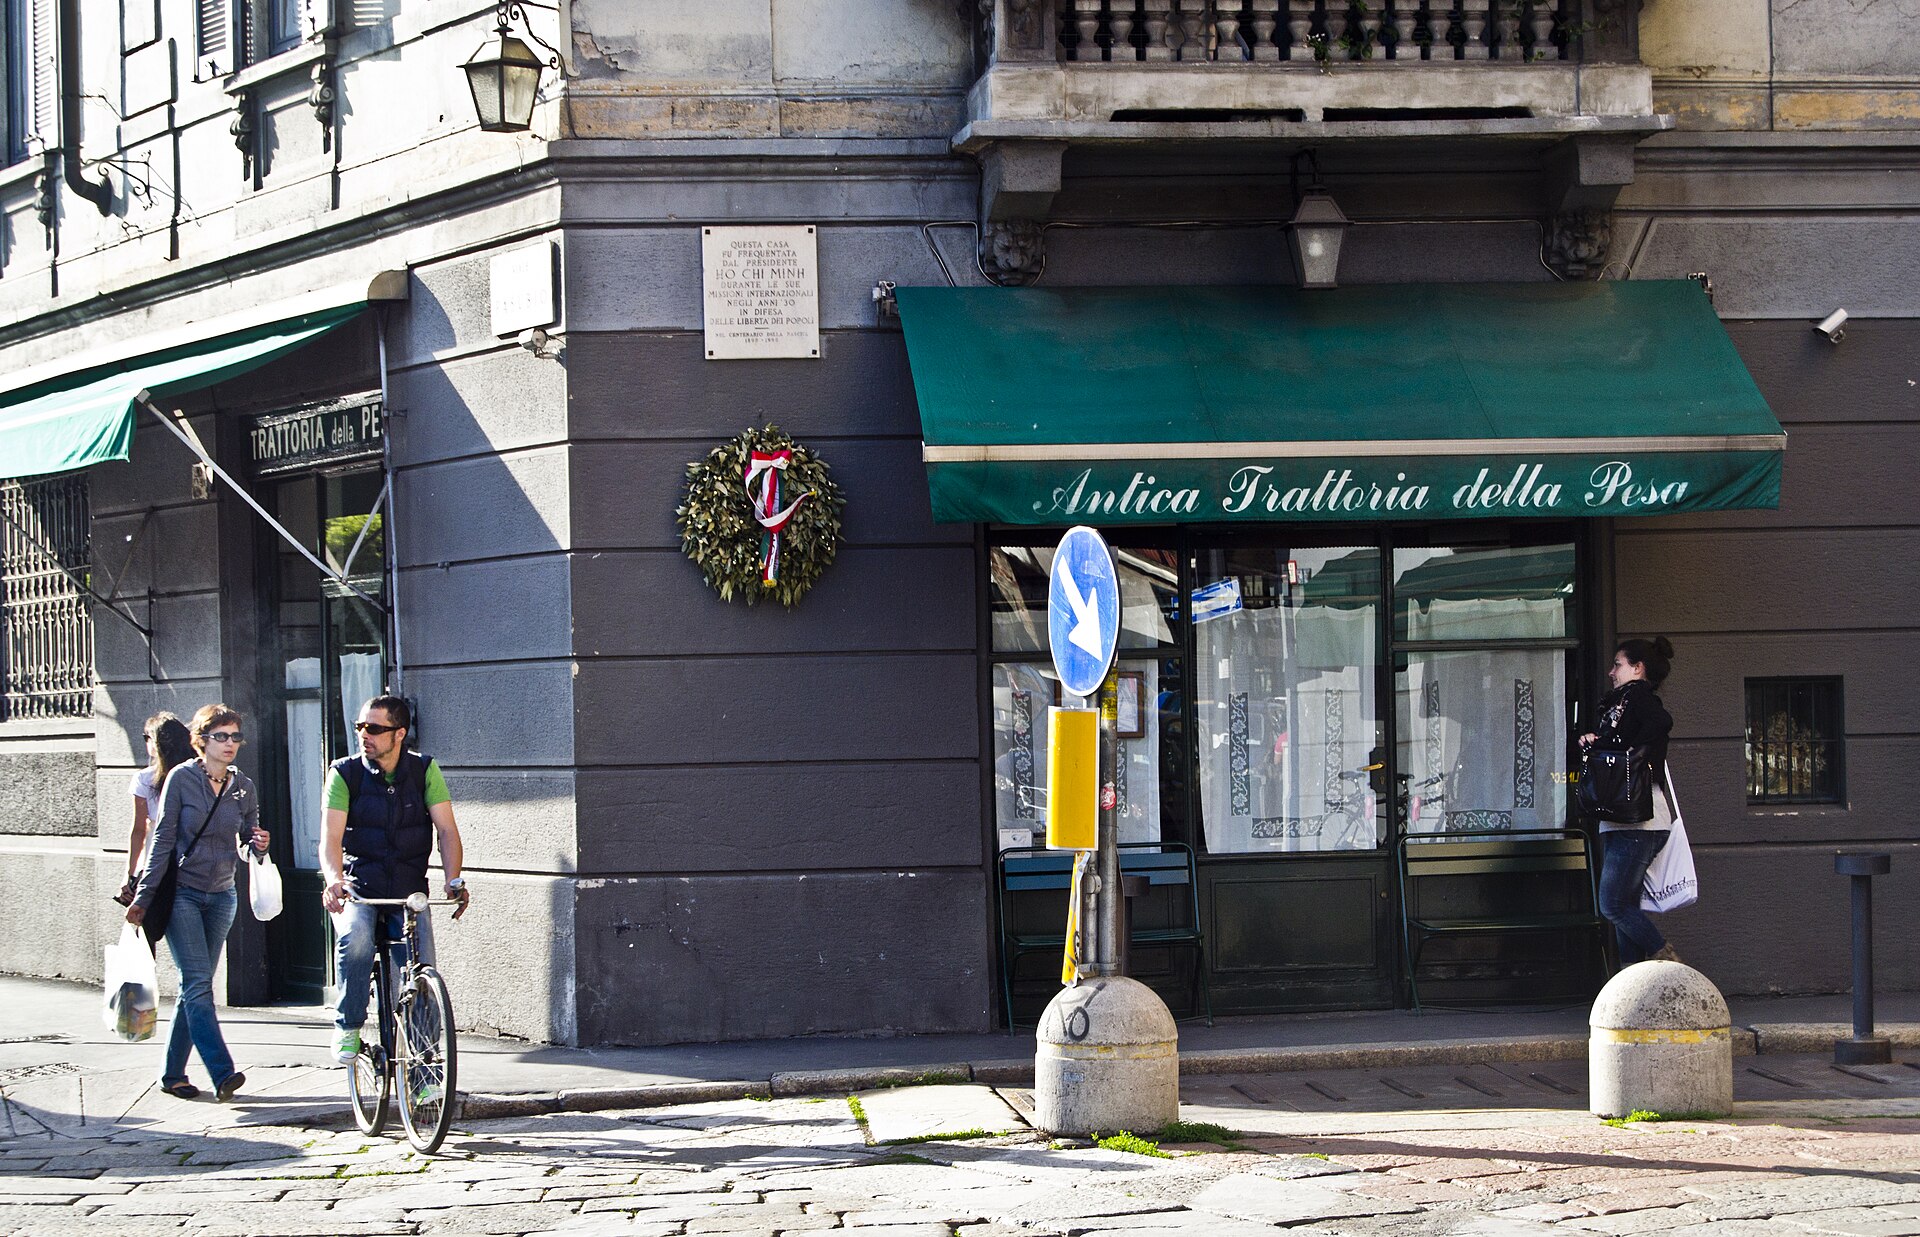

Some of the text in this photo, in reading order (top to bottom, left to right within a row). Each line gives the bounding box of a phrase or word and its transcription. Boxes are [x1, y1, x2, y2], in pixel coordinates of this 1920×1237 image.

[730, 240, 790, 249] QUESTA CASA
[722, 249, 797, 258] FU FREQUENTATA
[746, 258, 798, 266] PRESIDENTE
[715, 268, 805, 280] HO CHI MINH
[720, 281, 761, 289] DURANTE
[785, 280, 801, 288] SUE
[746, 289, 814, 297] INTERNAZIONALI
[727, 299, 753, 307] NEGLI
[757, 299, 778, 307] ANNI
[754, 308, 783, 316] DIFESA
[710, 318, 734, 326] DELLE
[771, 317, 784, 325] DEI
[786, 316, 814, 325] POPOLI
[250, 404, 384, 461] TRATTORIA della PE
[1032, 461, 1690, 515] Antica Trattoria della Pesa
